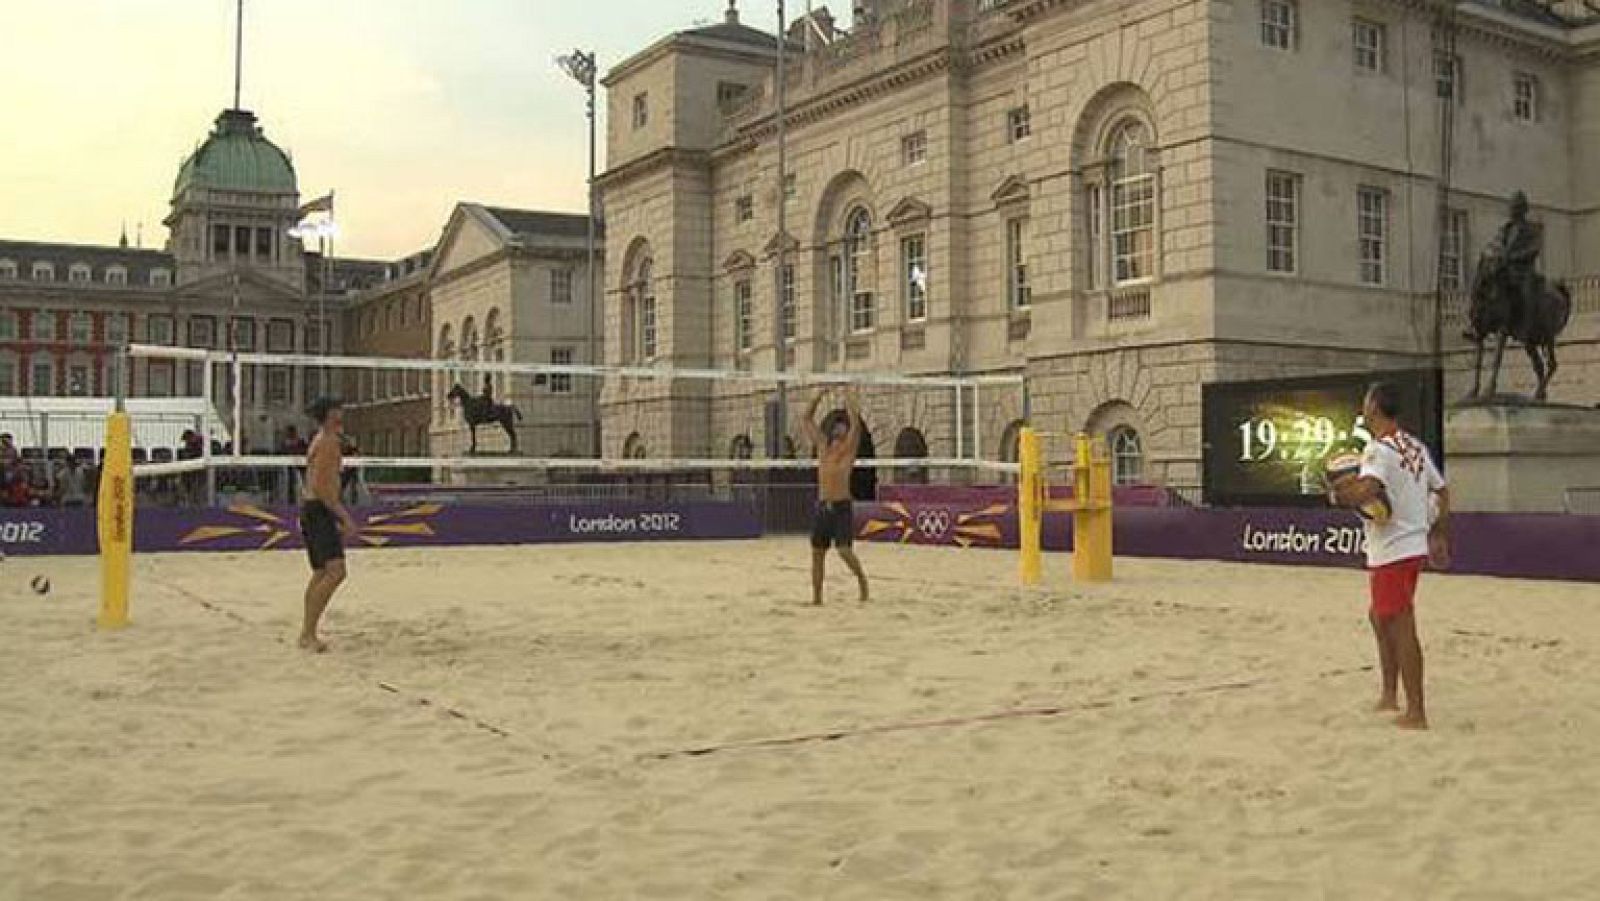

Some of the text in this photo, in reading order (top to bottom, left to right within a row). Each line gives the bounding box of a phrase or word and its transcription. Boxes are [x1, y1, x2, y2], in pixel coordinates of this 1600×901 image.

[0, 521, 44, 543] 012
[570, 512, 680, 532] London 2012
[1243, 523, 1319, 553] London
